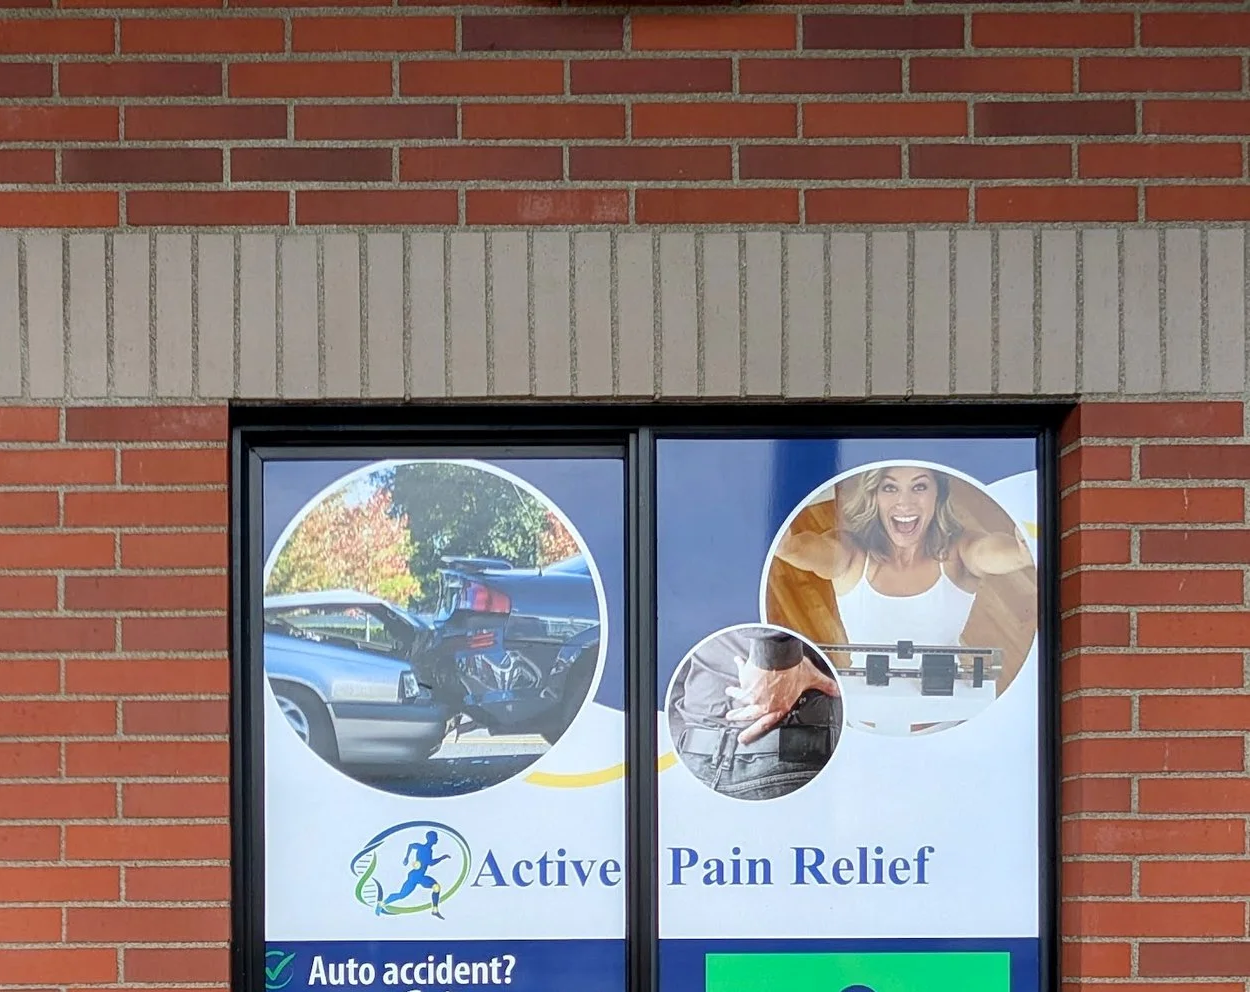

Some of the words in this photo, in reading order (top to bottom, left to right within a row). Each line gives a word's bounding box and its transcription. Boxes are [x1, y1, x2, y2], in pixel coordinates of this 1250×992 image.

[470, 846, 621, 888] Active
[667, 846, 772, 887] Pain
[790, 845, 935, 887] Relief
[308, 955, 375, 986] Auto
[382, 954, 517, 986] accident?
